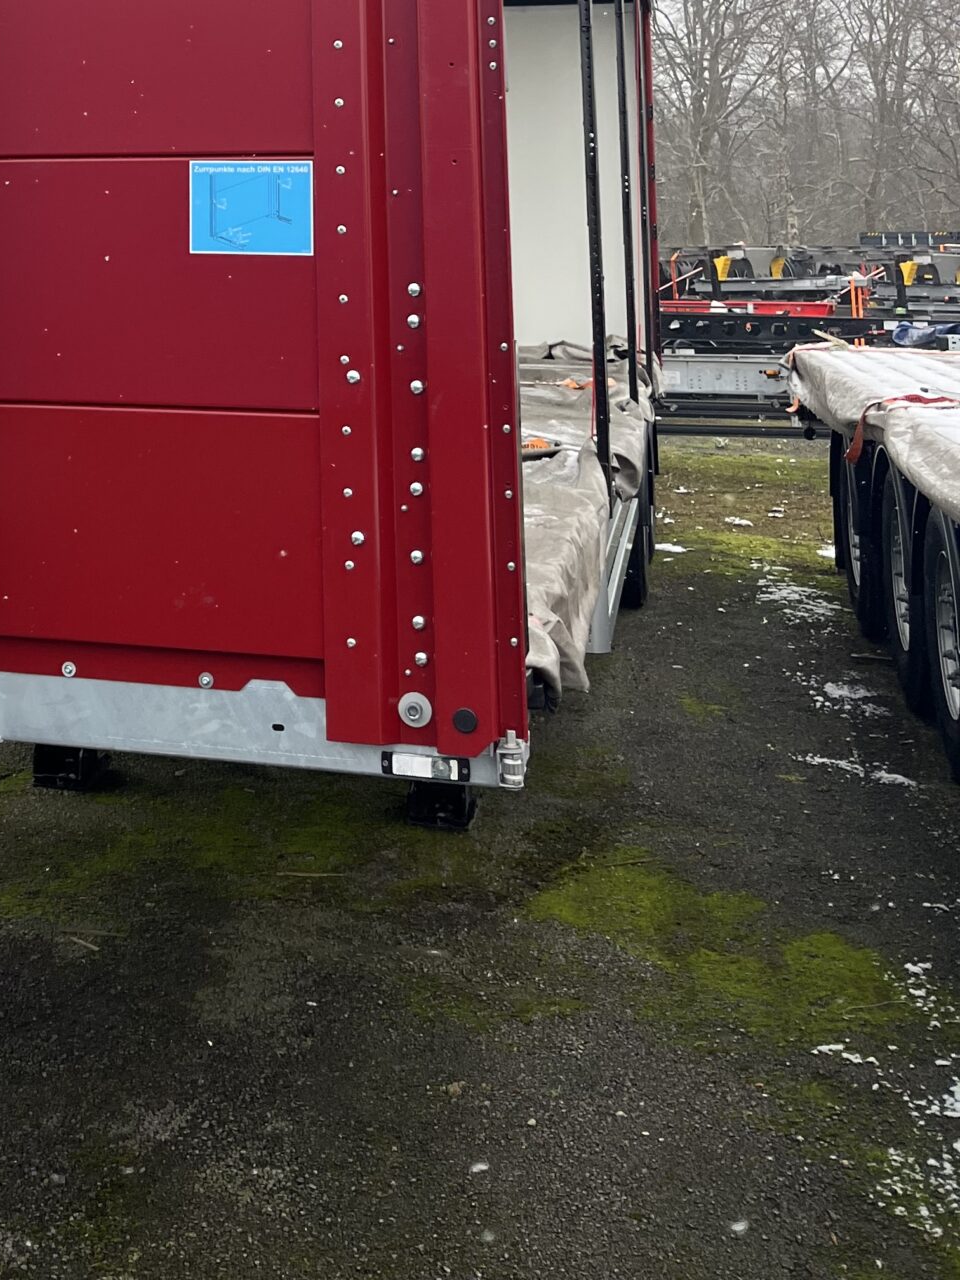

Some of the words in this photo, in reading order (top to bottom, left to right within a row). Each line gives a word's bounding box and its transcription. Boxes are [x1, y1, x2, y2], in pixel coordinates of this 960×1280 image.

[237, 165, 255, 173] nach
[257, 165, 270, 173] DIN
[273, 165, 283, 173] EN
